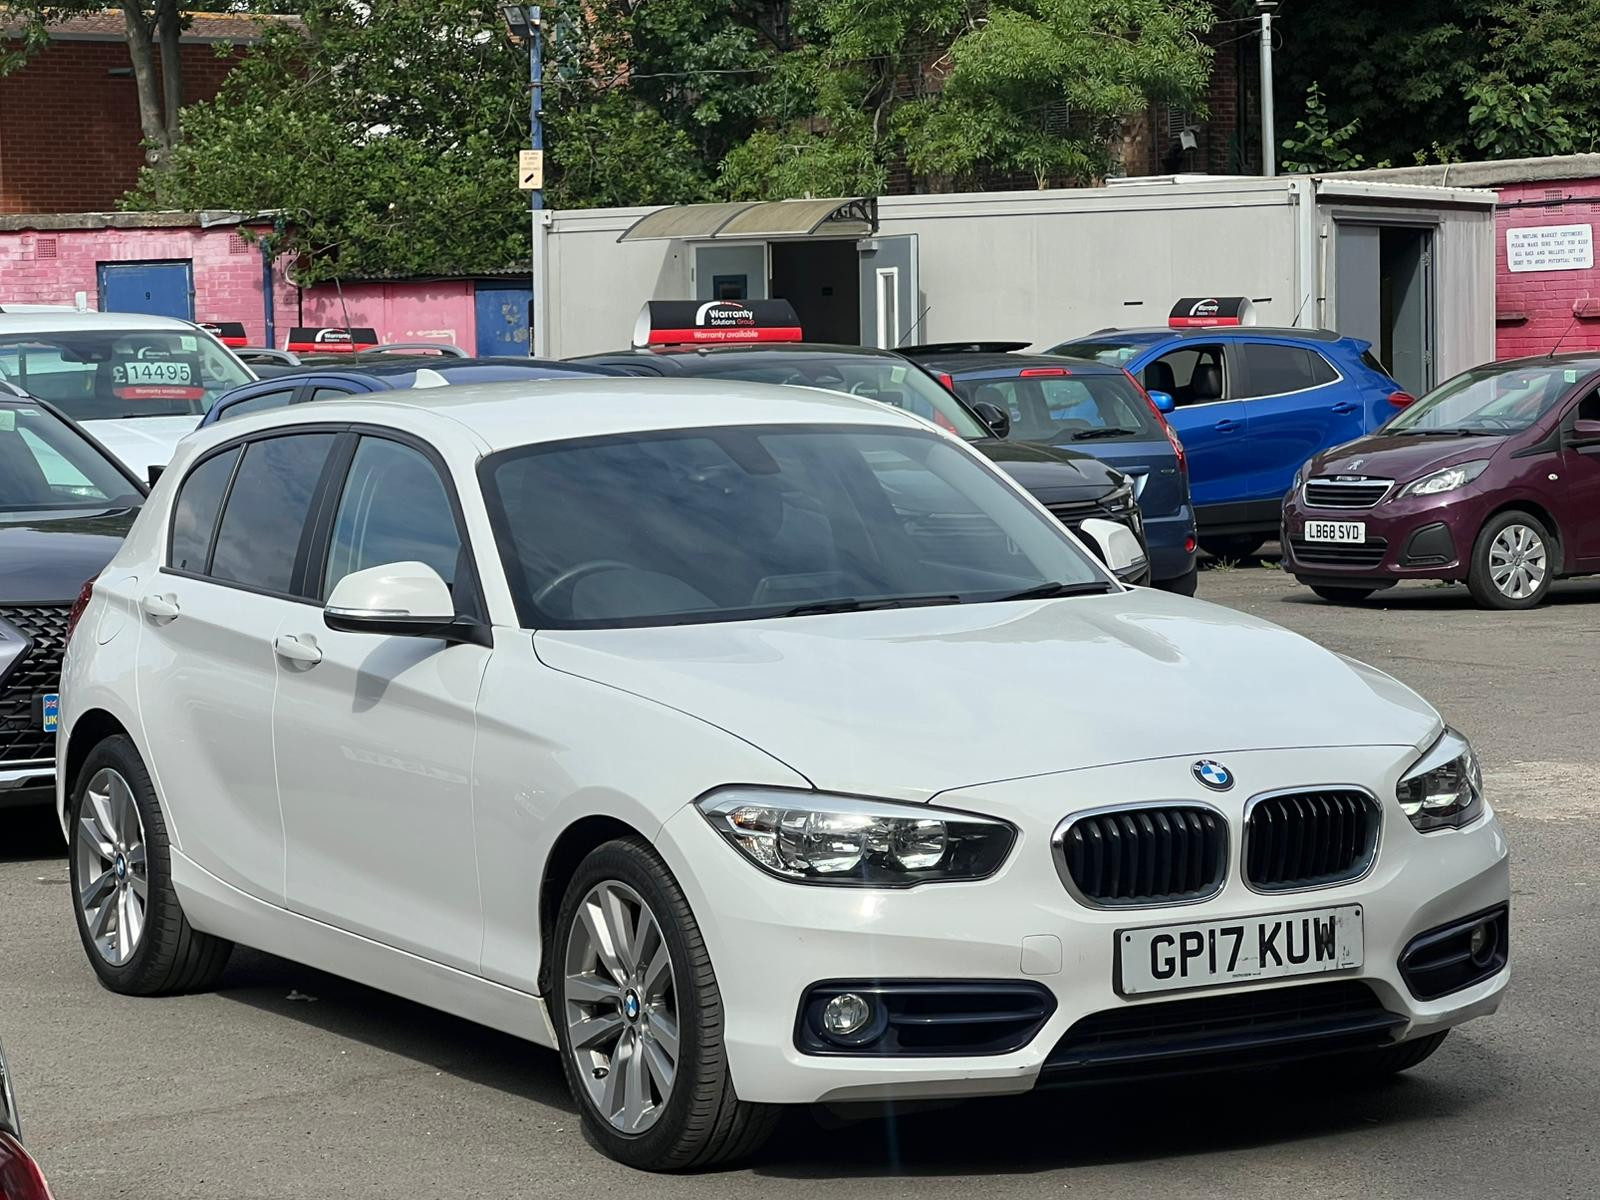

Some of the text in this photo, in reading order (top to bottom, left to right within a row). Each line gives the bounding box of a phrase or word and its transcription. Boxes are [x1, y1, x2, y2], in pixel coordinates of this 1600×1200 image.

[145, 292, 151, 301] 9
[708, 309, 754, 320] Warranty
[693, 330, 759, 340] Warranty available
[1309, 523, 1359, 541] LB68 SVD
[45, 715, 57, 725] UK
[1149, 914, 1336, 980] GP17 KUW
